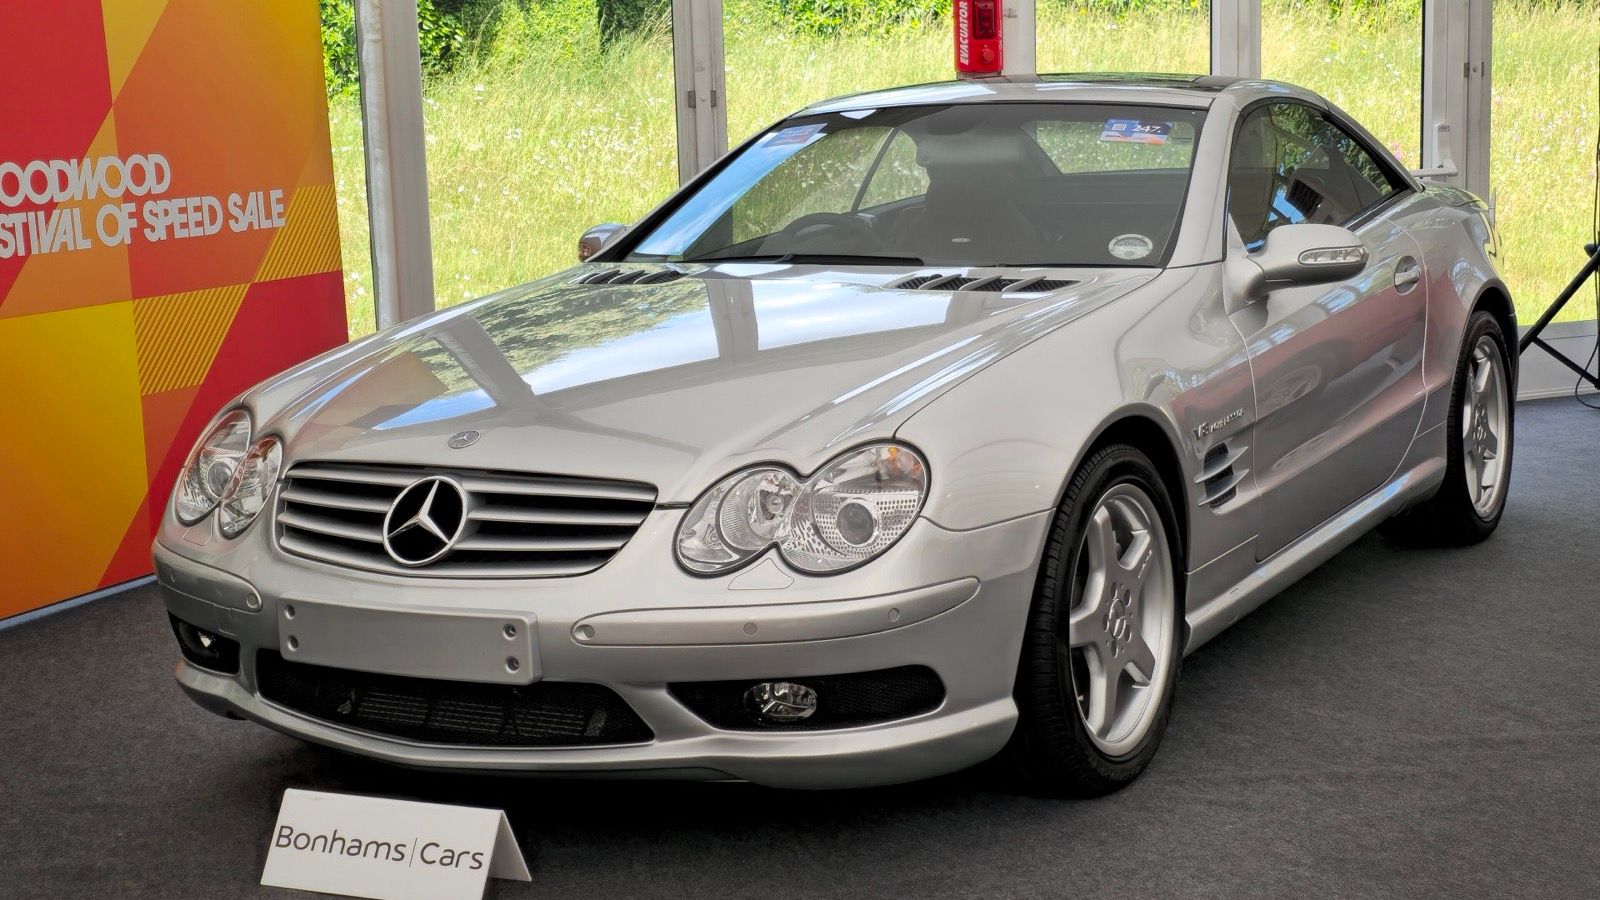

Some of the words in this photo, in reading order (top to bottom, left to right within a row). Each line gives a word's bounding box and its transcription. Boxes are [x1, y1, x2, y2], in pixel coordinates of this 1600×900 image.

[959, 1, 969, 66] EVACUATOR
[0, 154, 171, 207] OODWOOD
[0, 207, 91, 259] STIVAL
[96, 203, 137, 247] OF
[143, 196, 224, 242] SPEED
[227, 189, 286, 233] SALE
[275, 825, 407, 862] Bonhams
[420, 842, 485, 870] Cars
